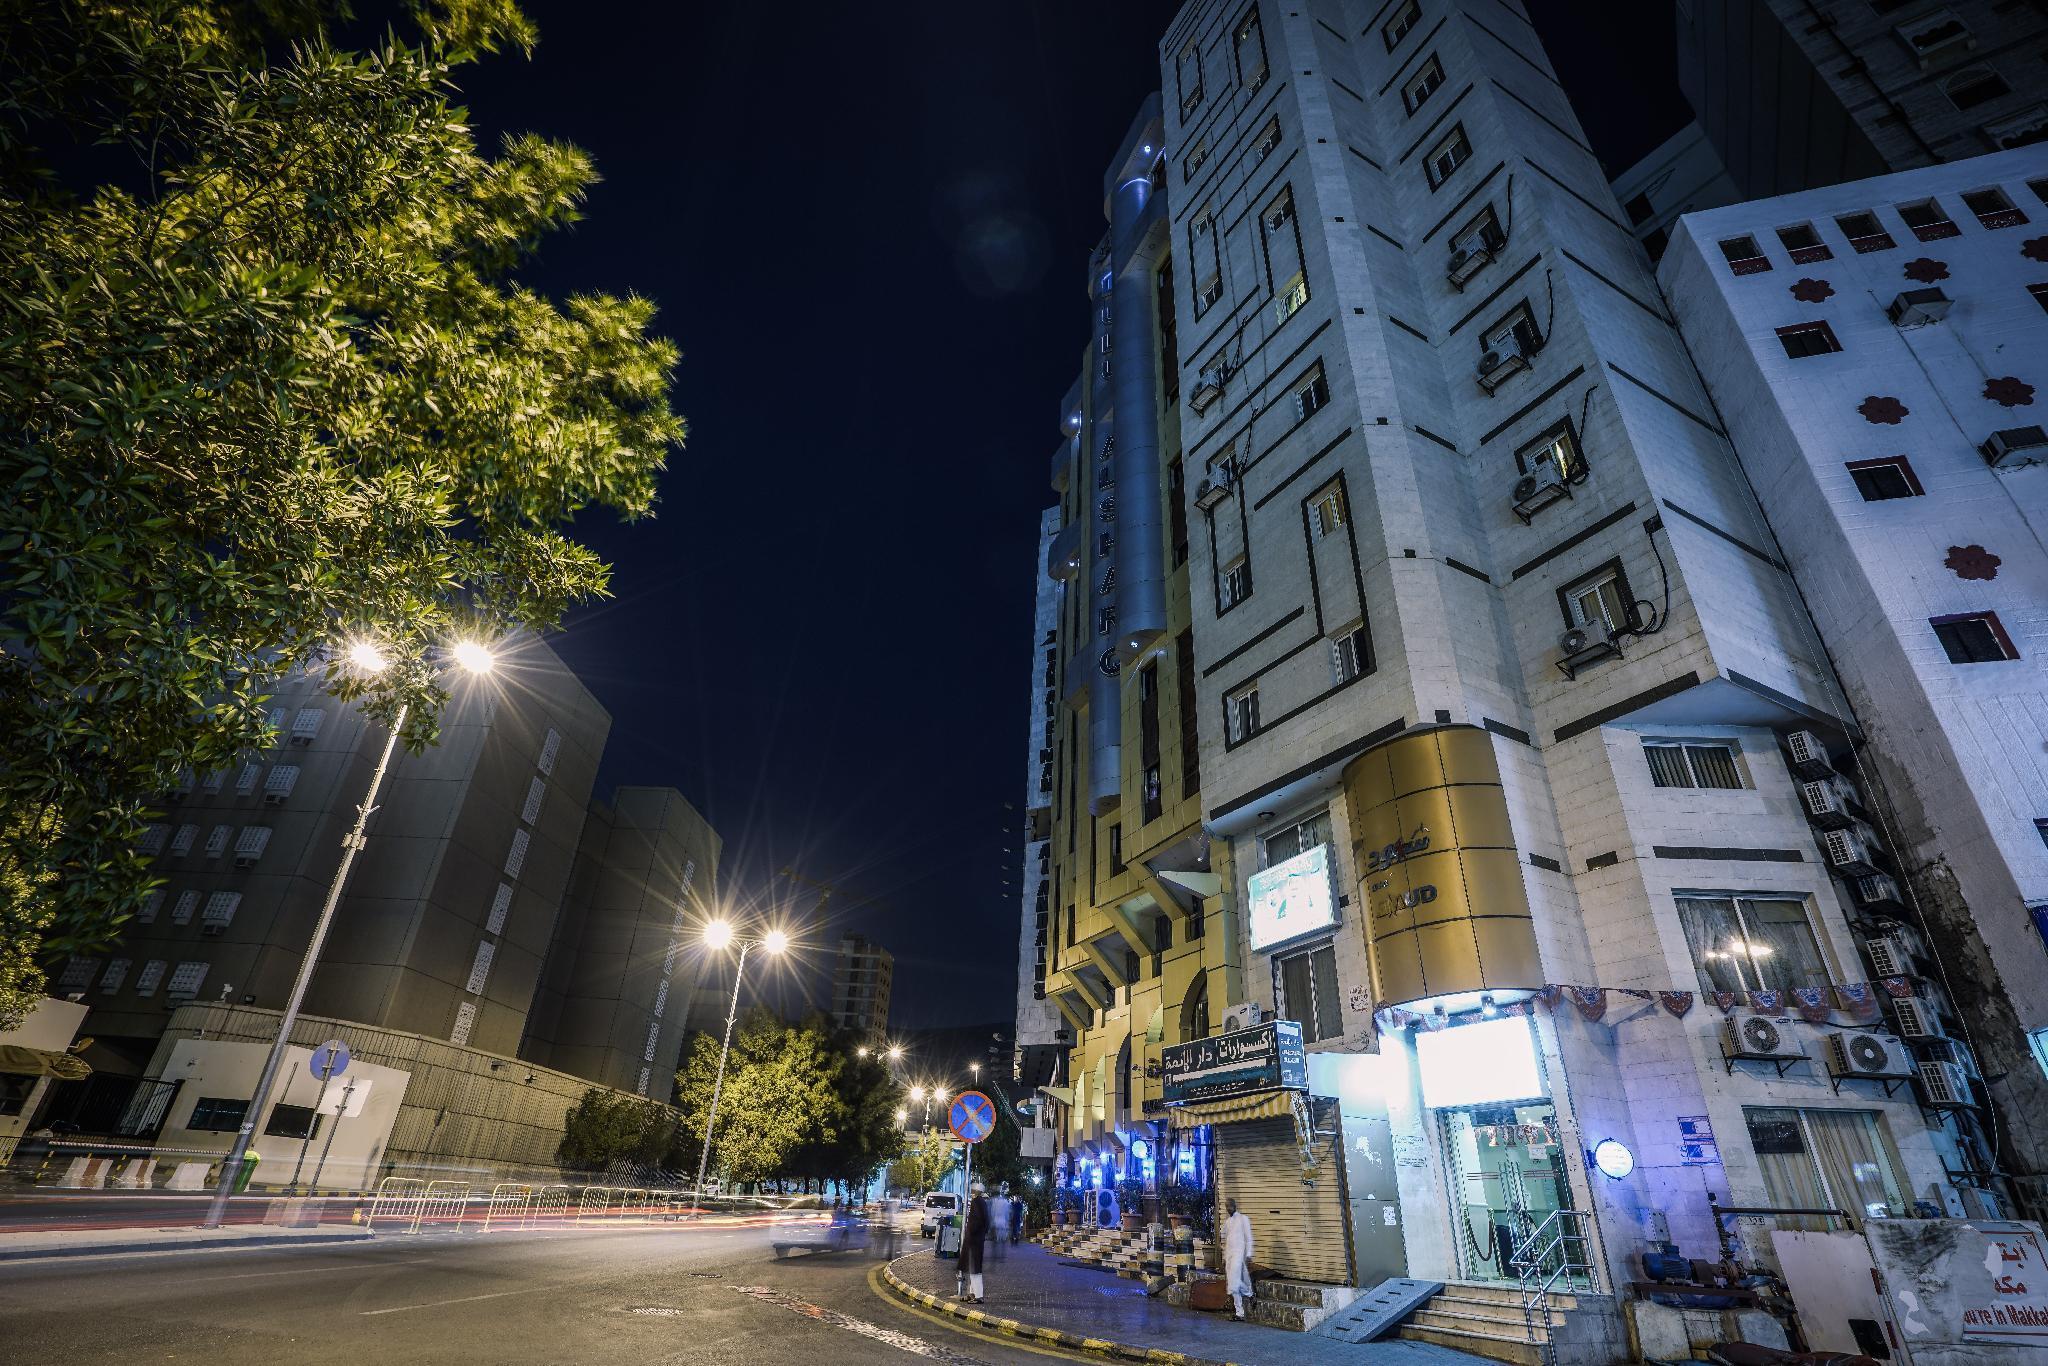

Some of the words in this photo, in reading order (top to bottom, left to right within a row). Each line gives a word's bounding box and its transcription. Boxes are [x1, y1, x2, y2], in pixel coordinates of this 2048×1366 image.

[1197, 1047, 1213, 1069] دار
[1991, 1304, 2007, 1325] in
[2004, 1304, 2048, 1327] Makka
